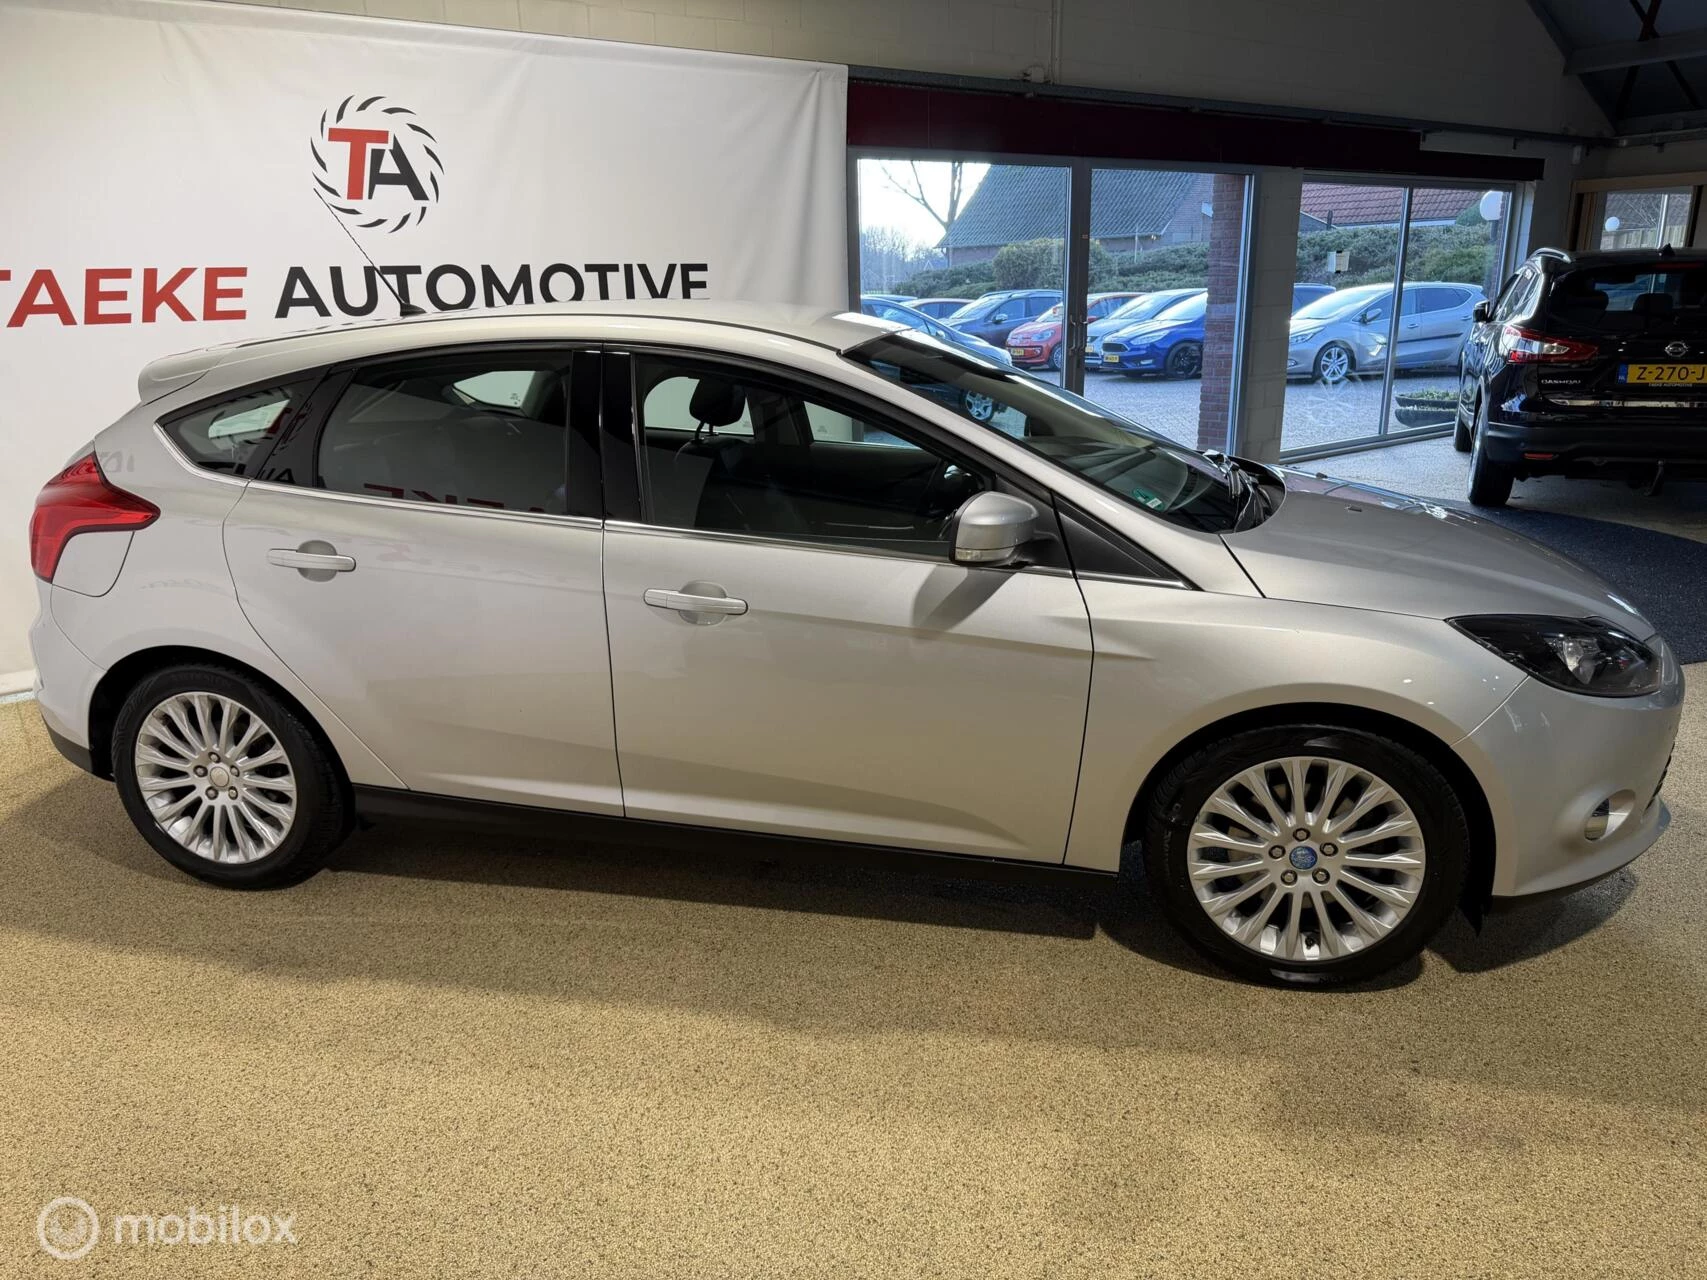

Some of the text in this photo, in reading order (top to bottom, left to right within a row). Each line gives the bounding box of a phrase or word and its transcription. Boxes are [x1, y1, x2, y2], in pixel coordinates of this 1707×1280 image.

[328, 127, 430, 201] TA
[0, 263, 709, 328] AEKE AUTOMOTIVE
[1636, 366, 1706, 381] Z-270-J
